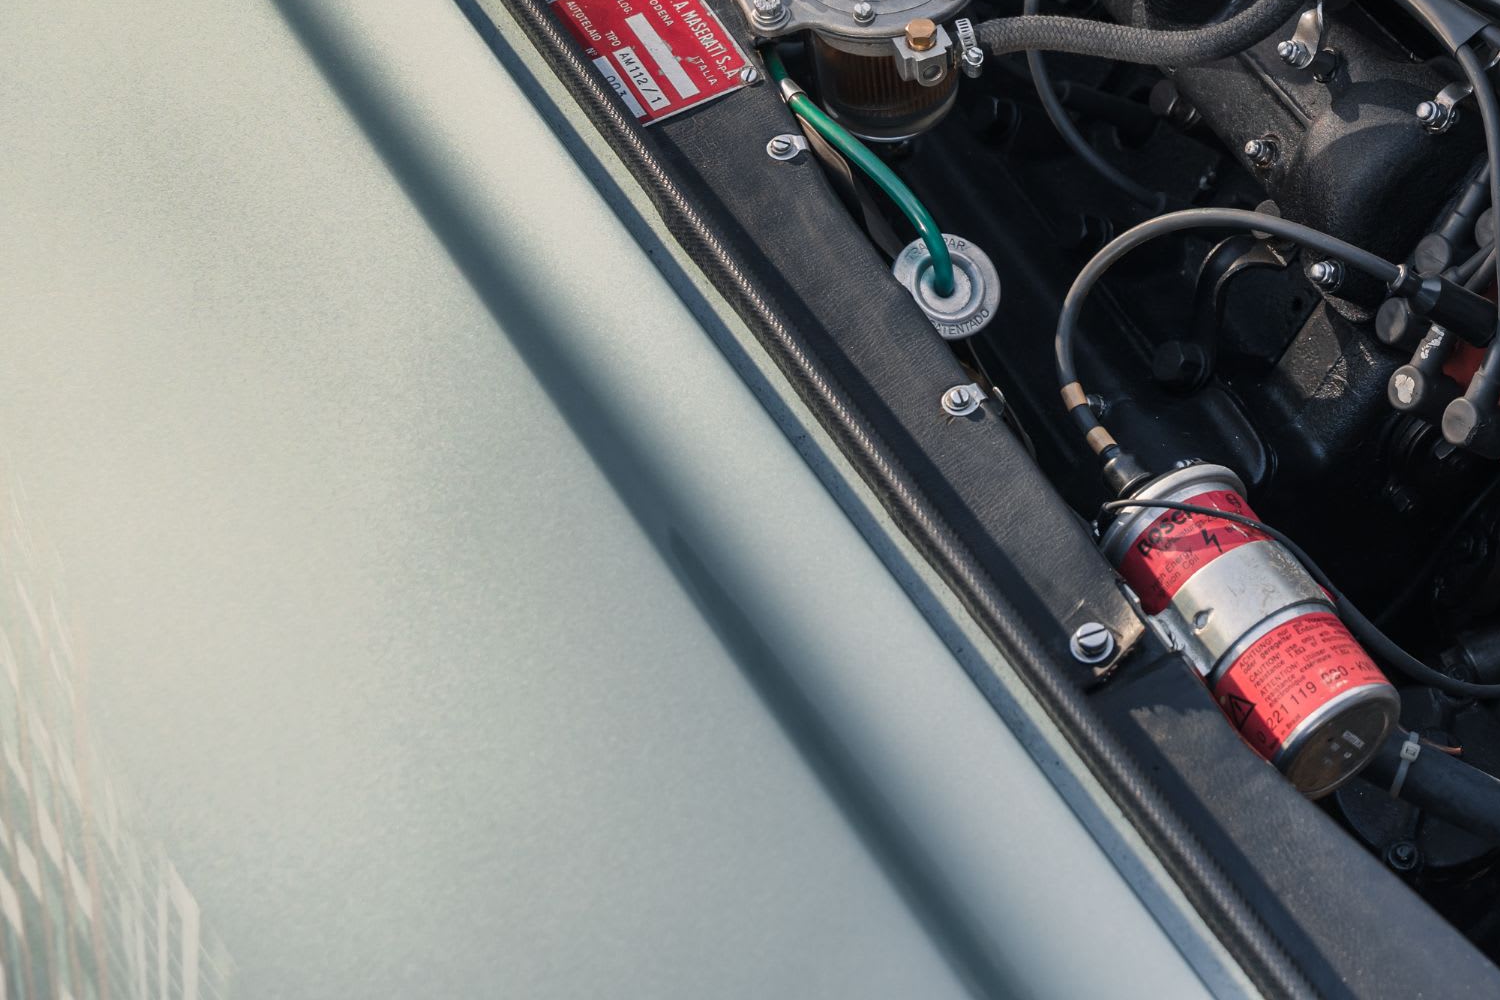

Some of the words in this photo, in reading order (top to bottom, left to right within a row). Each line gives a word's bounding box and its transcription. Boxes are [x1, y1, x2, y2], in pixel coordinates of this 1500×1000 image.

[567, 1, 602, 42] AUTOTELAIO
[680, 10, 727, 57] MASERATI
[605, 31, 620, 46] TIPO
[693, 57, 718, 86] ITALIA
[1165, 547, 1193, 574] Energy
[1182, 556, 1199, 570] Coil
[1239, 638, 1273, 669] ACHTUNG!
[1249, 652, 1281, 682] CAUTION!
[1266, 704, 1289, 730] 221
[1290, 681, 1317, 706] 119
